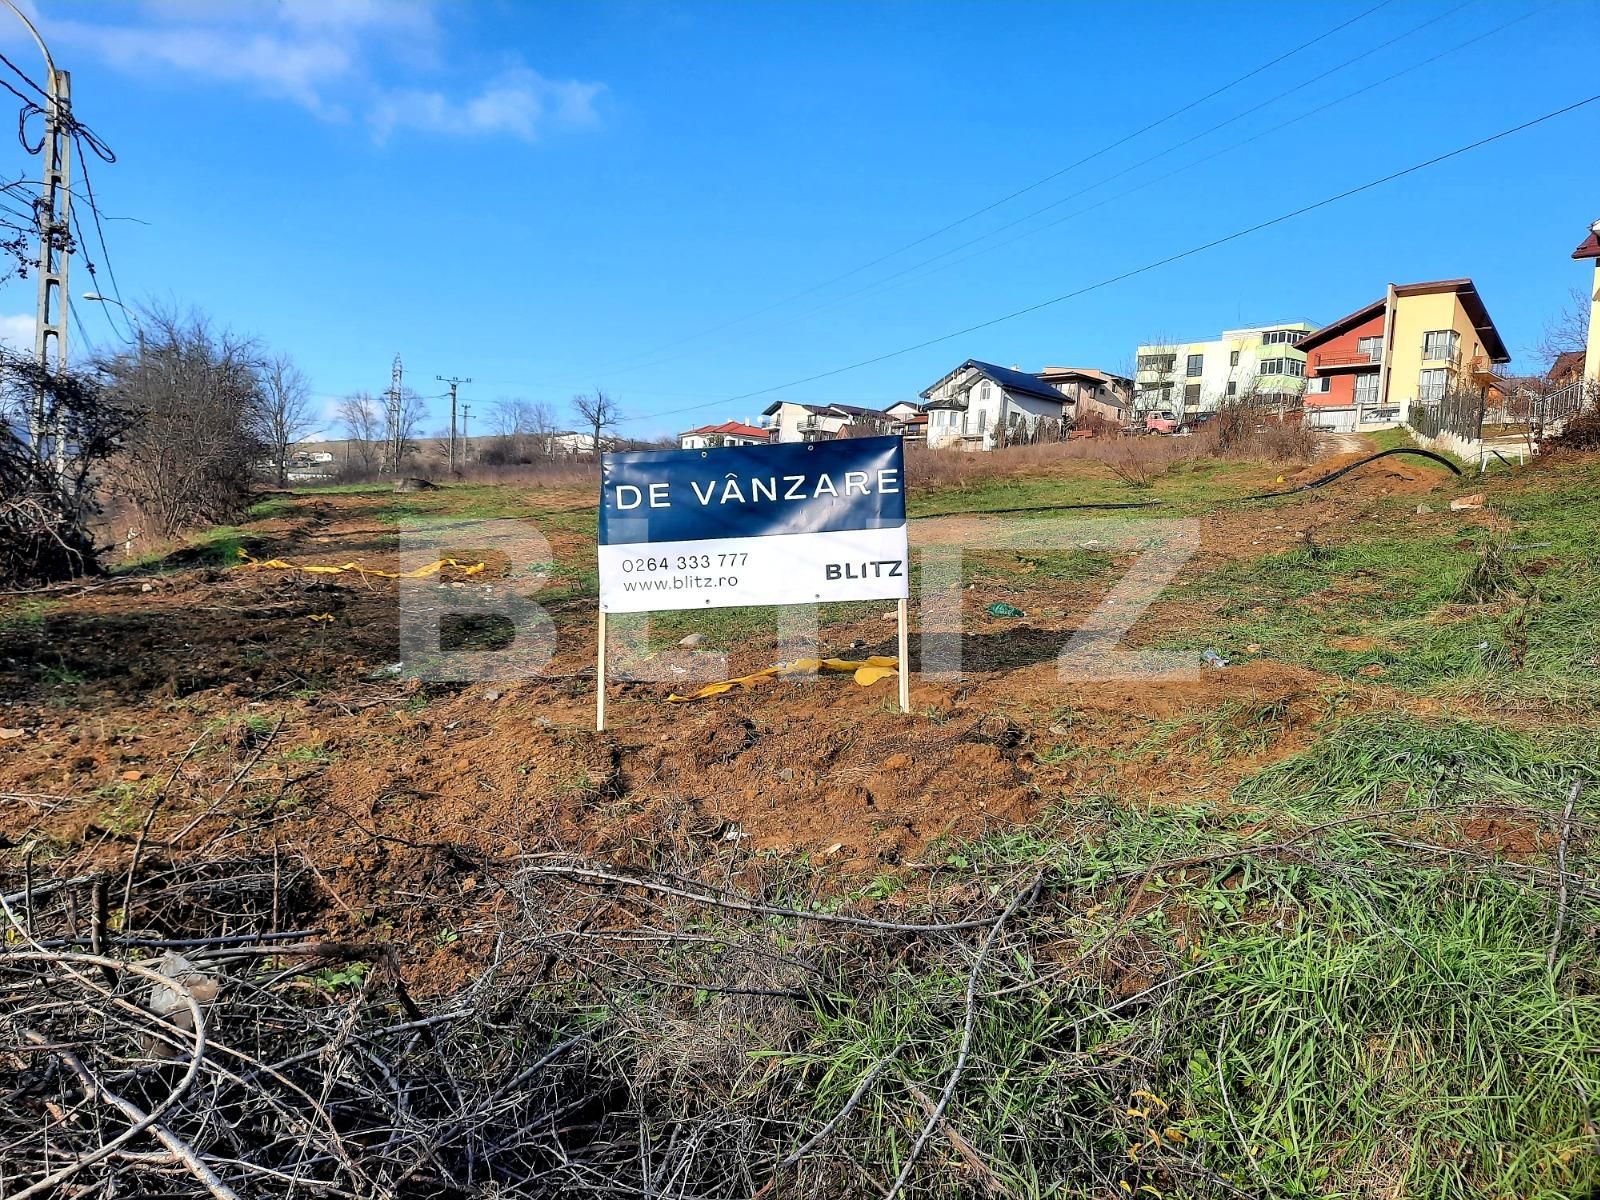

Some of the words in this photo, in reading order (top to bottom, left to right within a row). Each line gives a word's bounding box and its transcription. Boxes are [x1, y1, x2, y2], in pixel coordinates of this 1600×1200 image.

[616, 483, 671, 510] DE
[690, 468, 899, 505] VÂNZARE
[622, 557, 669, 573] 0264
[677, 555, 711, 570] 333
[718, 553, 749, 568] 777
[825, 560, 903, 580] BLITZ
[623, 576, 739, 592] www.blitz.ro
